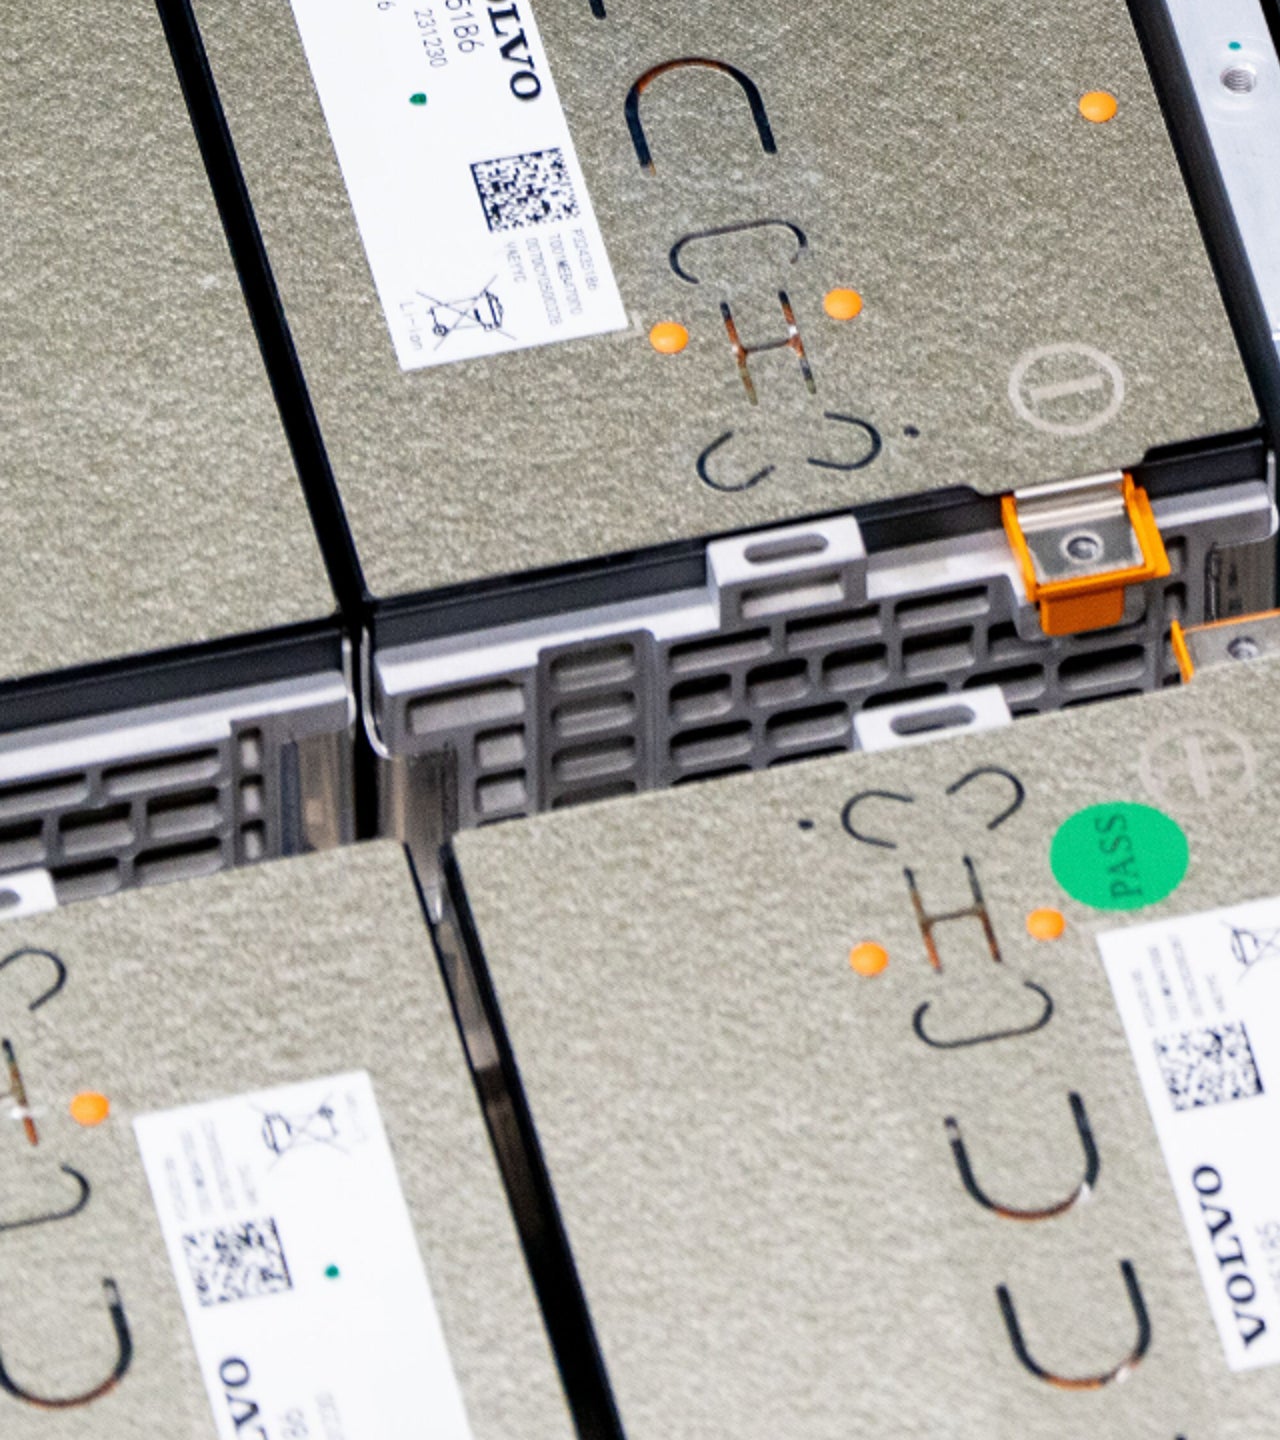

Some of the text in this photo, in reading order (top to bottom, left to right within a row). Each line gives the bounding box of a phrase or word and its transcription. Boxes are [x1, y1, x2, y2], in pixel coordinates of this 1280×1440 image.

[414, 8, 448, 67] 231230
[1094, 813, 1144, 901] PASS
[1192, 1164, 1267, 1347] VOLVO
